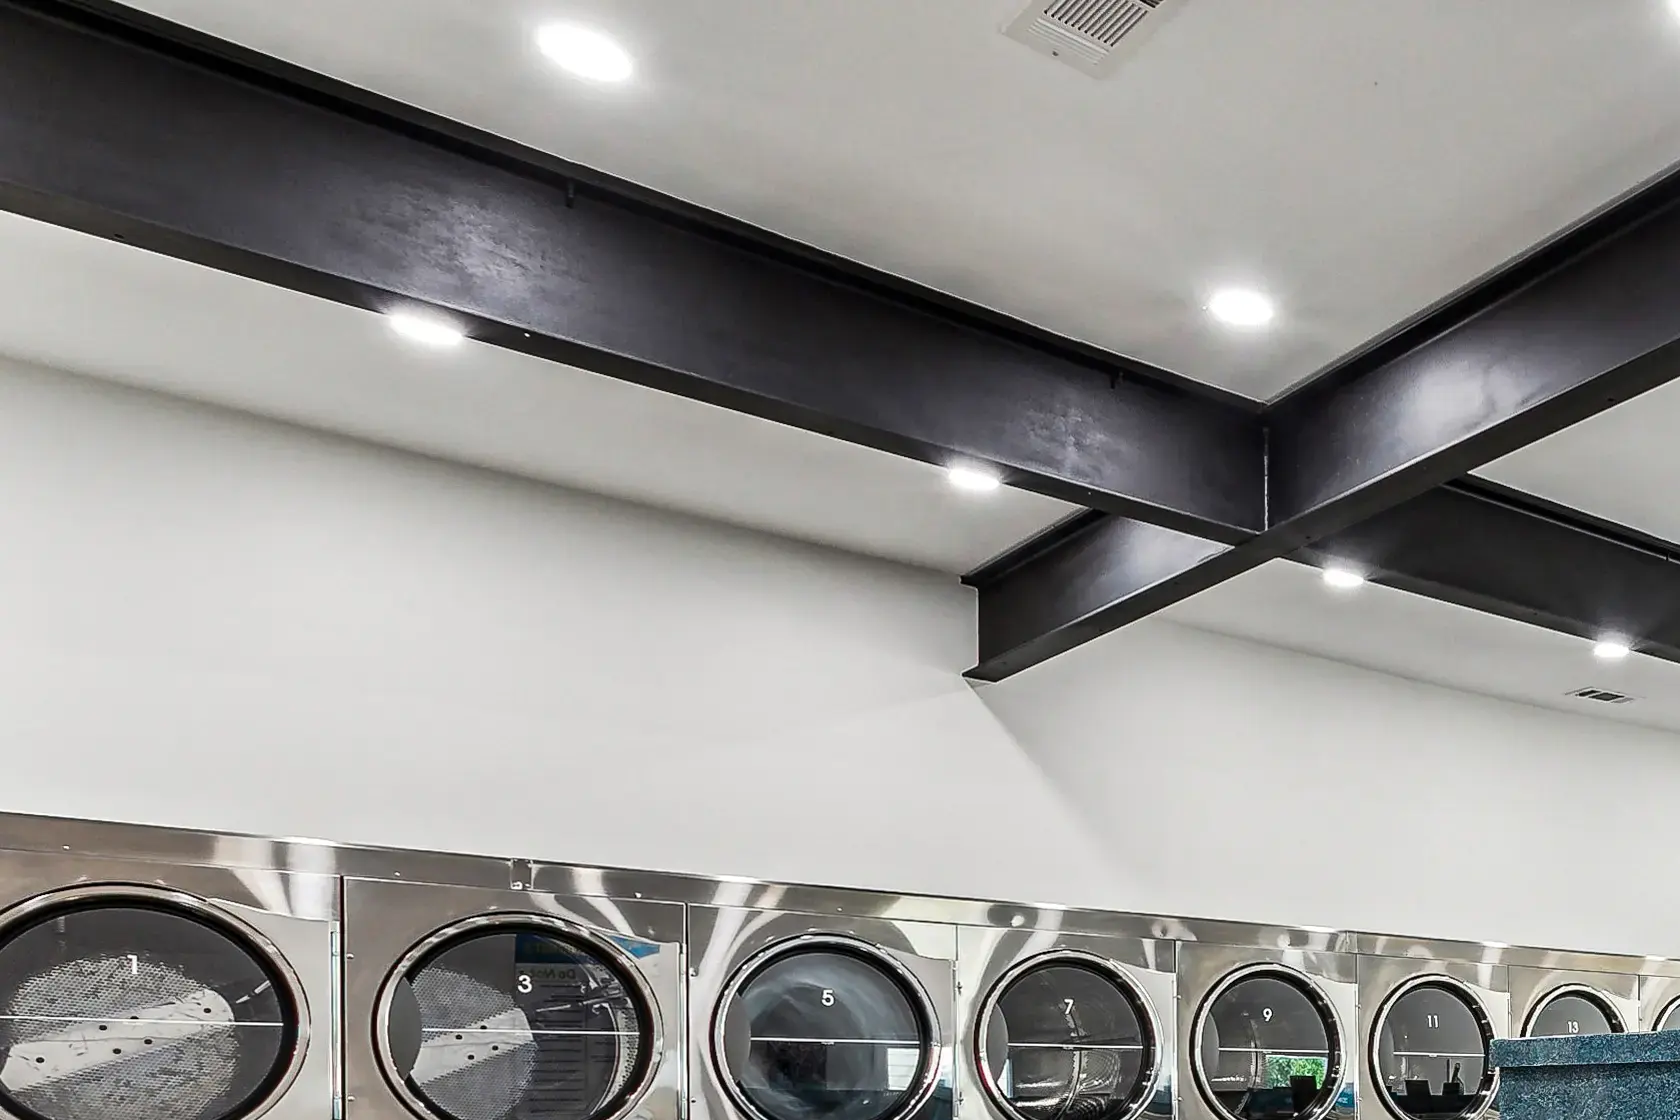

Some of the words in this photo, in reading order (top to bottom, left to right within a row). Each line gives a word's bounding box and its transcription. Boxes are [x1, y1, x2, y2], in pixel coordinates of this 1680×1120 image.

[127, 954, 139, 975] 1
[517, 975, 532, 993] 3
[821, 989, 834, 1006] 5
[1064, 998, 1074, 1015] 7
[1263, 1008, 1273, 1022] 9
[1427, 1015, 1439, 1028] 11
[1567, 1021, 1579, 1034] 13
